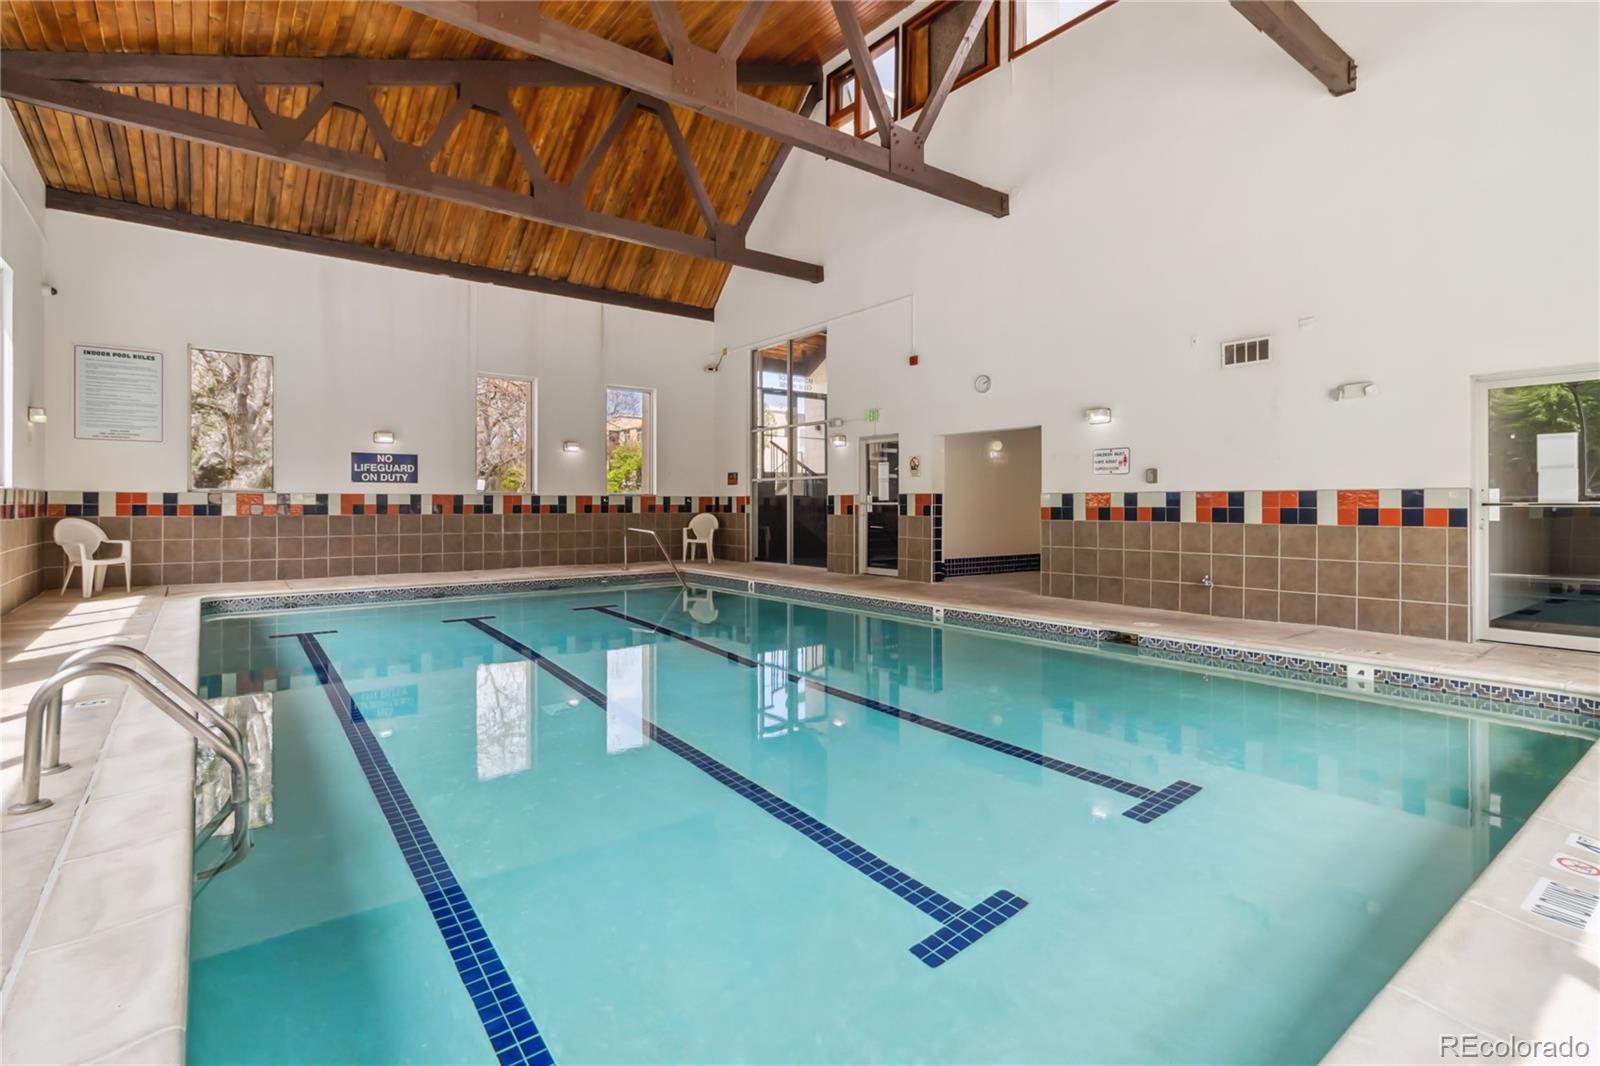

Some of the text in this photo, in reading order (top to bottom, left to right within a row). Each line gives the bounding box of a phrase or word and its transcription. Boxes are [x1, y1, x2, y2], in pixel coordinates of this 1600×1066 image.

[377, 455, 393, 463] NO
[354, 463, 415, 473] LIFEGUARD
[361, 473, 409, 482] ON DUTY
